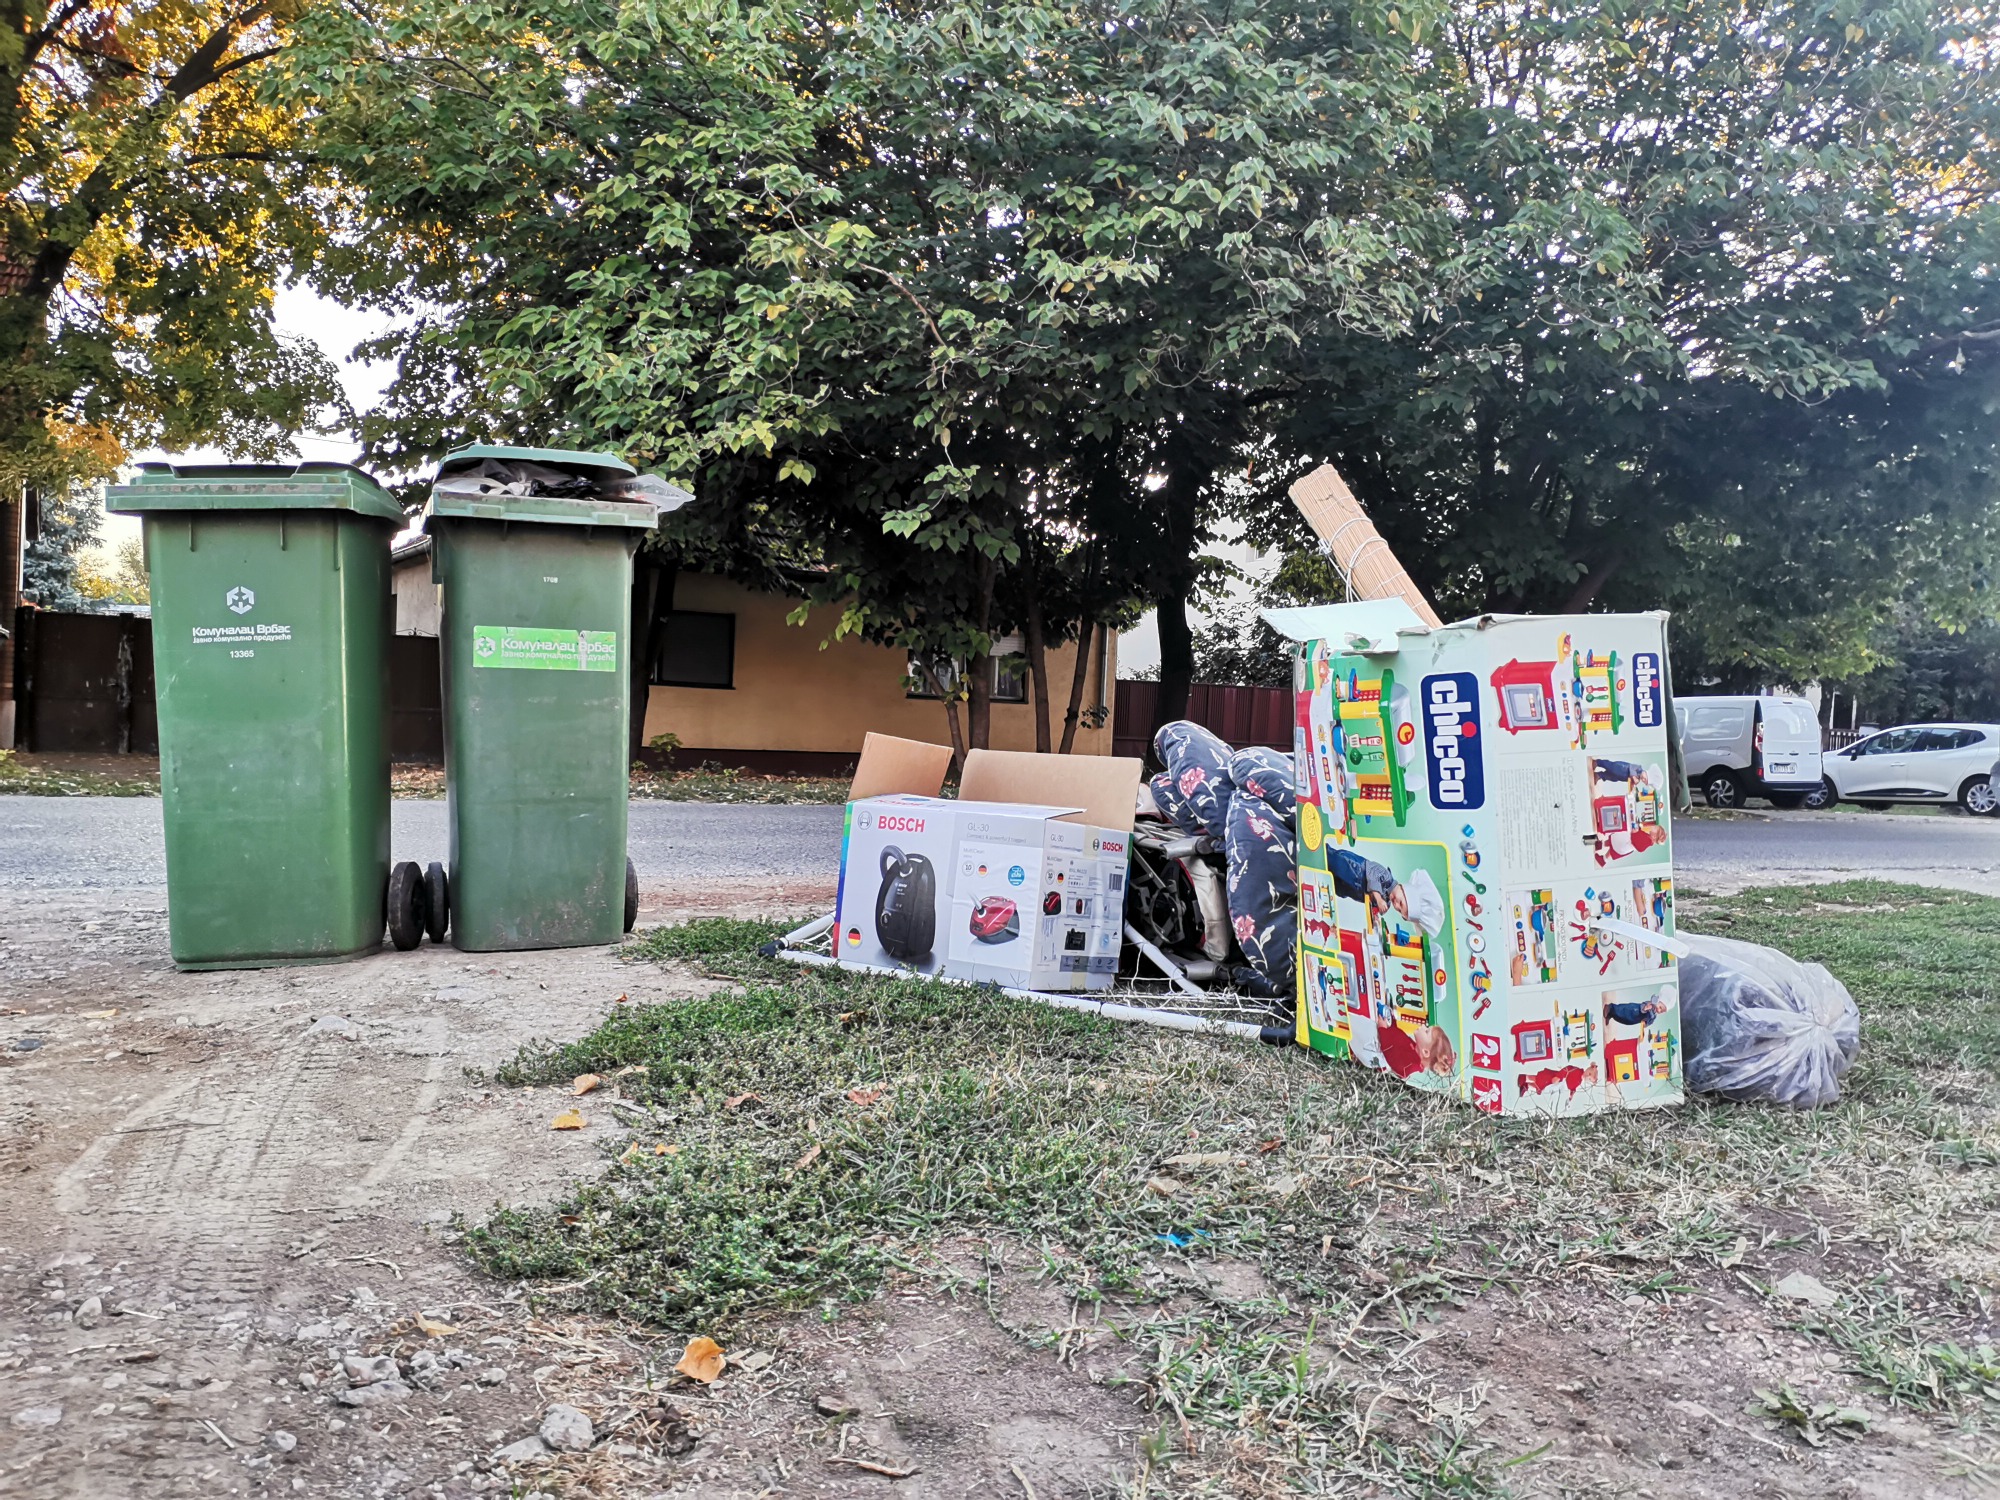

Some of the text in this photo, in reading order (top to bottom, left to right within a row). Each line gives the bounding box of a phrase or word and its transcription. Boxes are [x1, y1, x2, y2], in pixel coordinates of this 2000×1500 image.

[192, 624, 291, 637] Комуналац Врбас
[230, 650, 254, 658] 13365
[501, 638, 615, 654] Комуналац Врбас
[1636, 656, 1659, 724] chicco
[1429, 680, 1477, 803] chicco
[878, 815, 926, 833] BOSCH
[967, 822, 990, 832] GL-30
[1102, 841, 1124, 853] BOSCH
[1474, 1034, 1498, 1067] 2+
